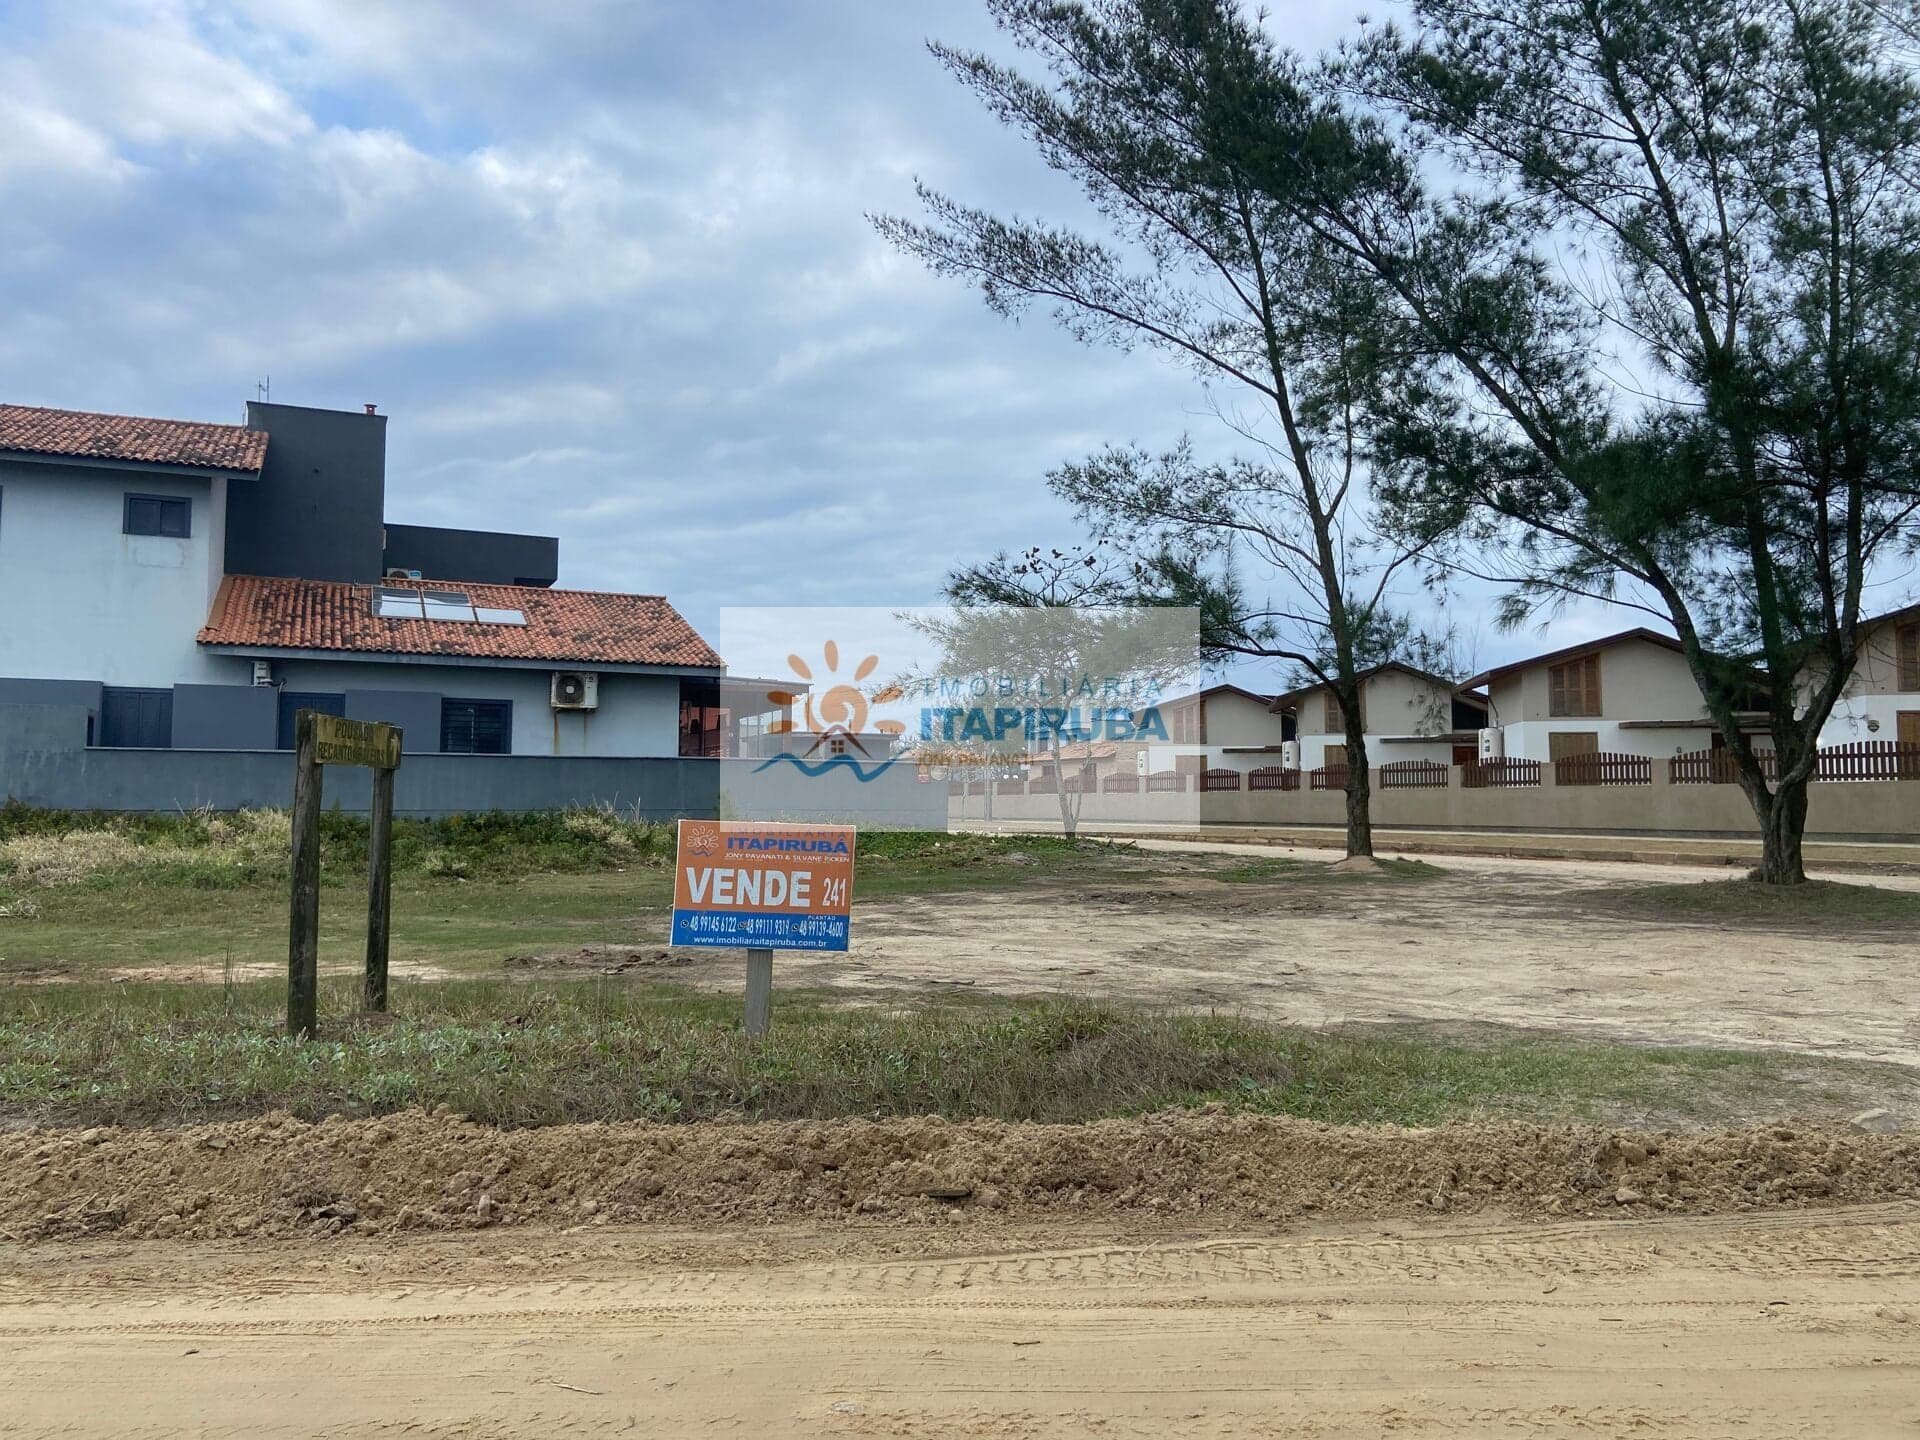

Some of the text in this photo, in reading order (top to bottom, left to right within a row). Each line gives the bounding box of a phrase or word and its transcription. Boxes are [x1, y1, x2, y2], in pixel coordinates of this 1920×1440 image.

[727, 837, 849, 854] ITAPIRUBÁ
[686, 867, 812, 907] VENDE
[822, 877, 846, 907] 241
[690, 915, 737, 933] 48 99145 6122
[799, 920, 807, 936] 48
[693, 935, 827, 948] www.imobiliariaitapiruba.com.br
